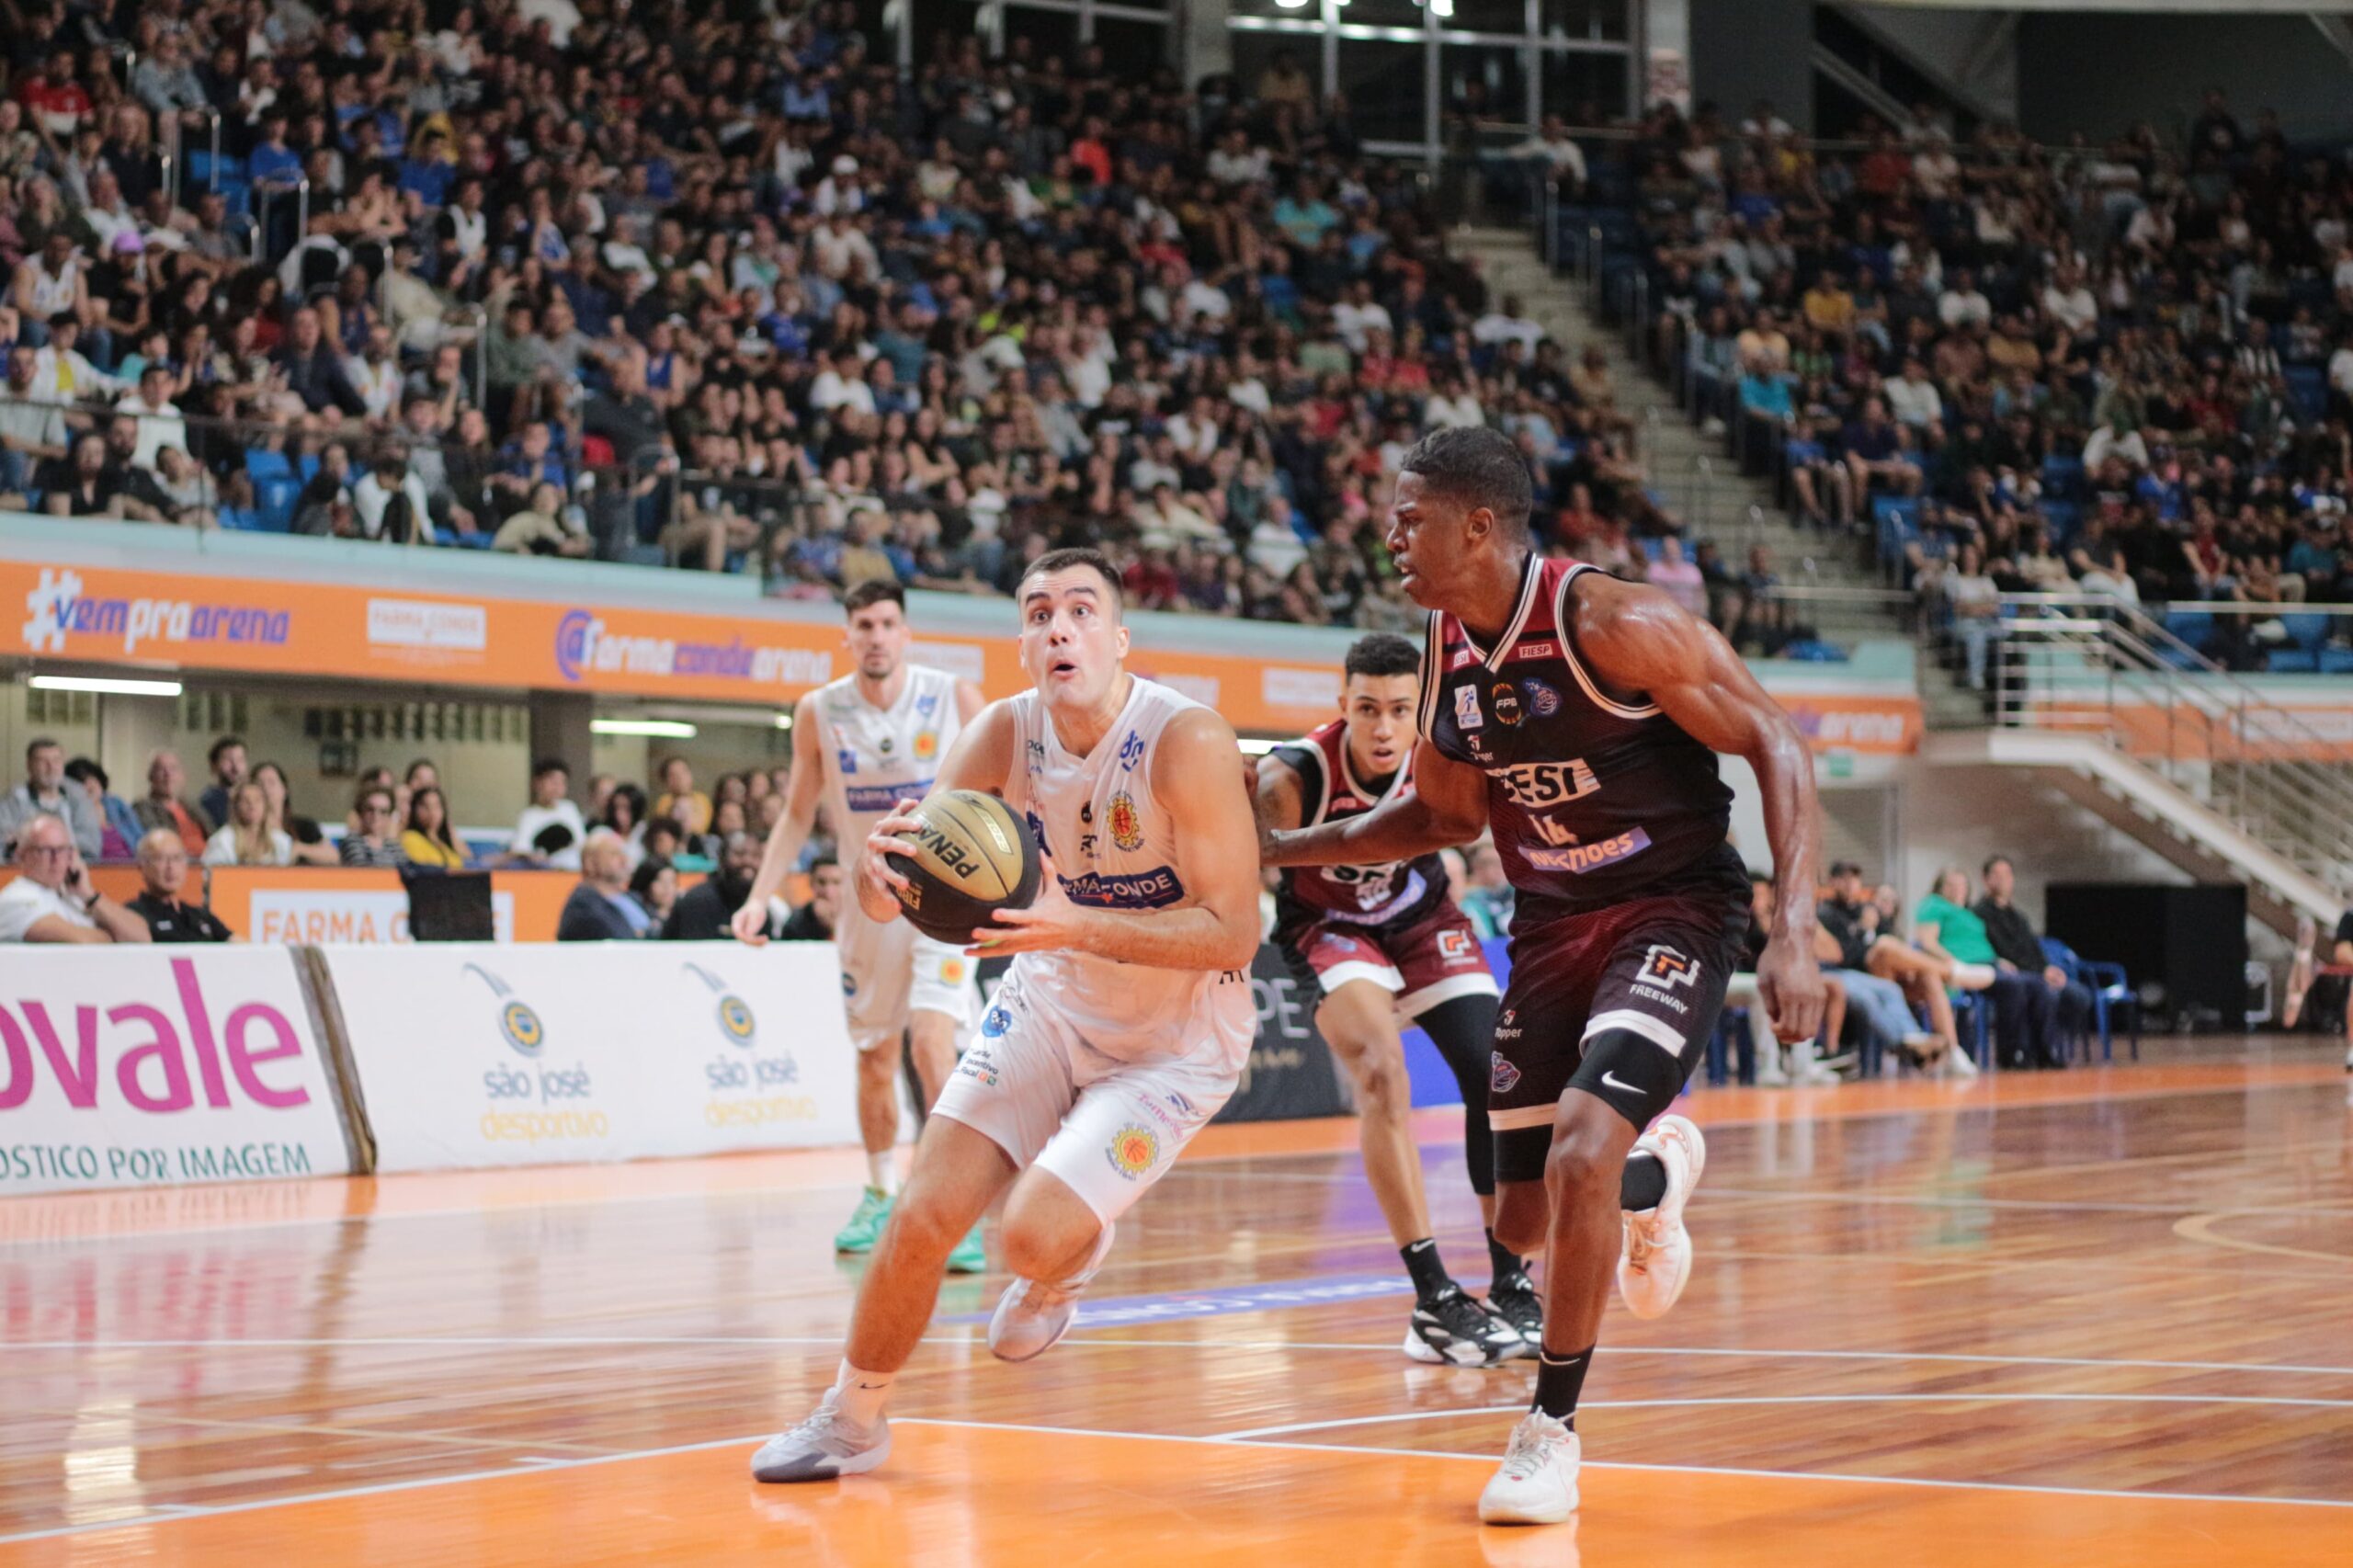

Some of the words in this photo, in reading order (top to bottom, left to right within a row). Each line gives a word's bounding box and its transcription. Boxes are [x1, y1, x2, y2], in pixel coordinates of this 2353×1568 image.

[1521, 645, 1550, 656] FIESP
[1495, 697, 1518, 710] FPB
[262, 910, 378, 943] FARMA
[1630, 983, 1688, 1015] FREEWAY
[108, 1146, 171, 1180] POR
[180, 1142, 312, 1177] IMAGEM
